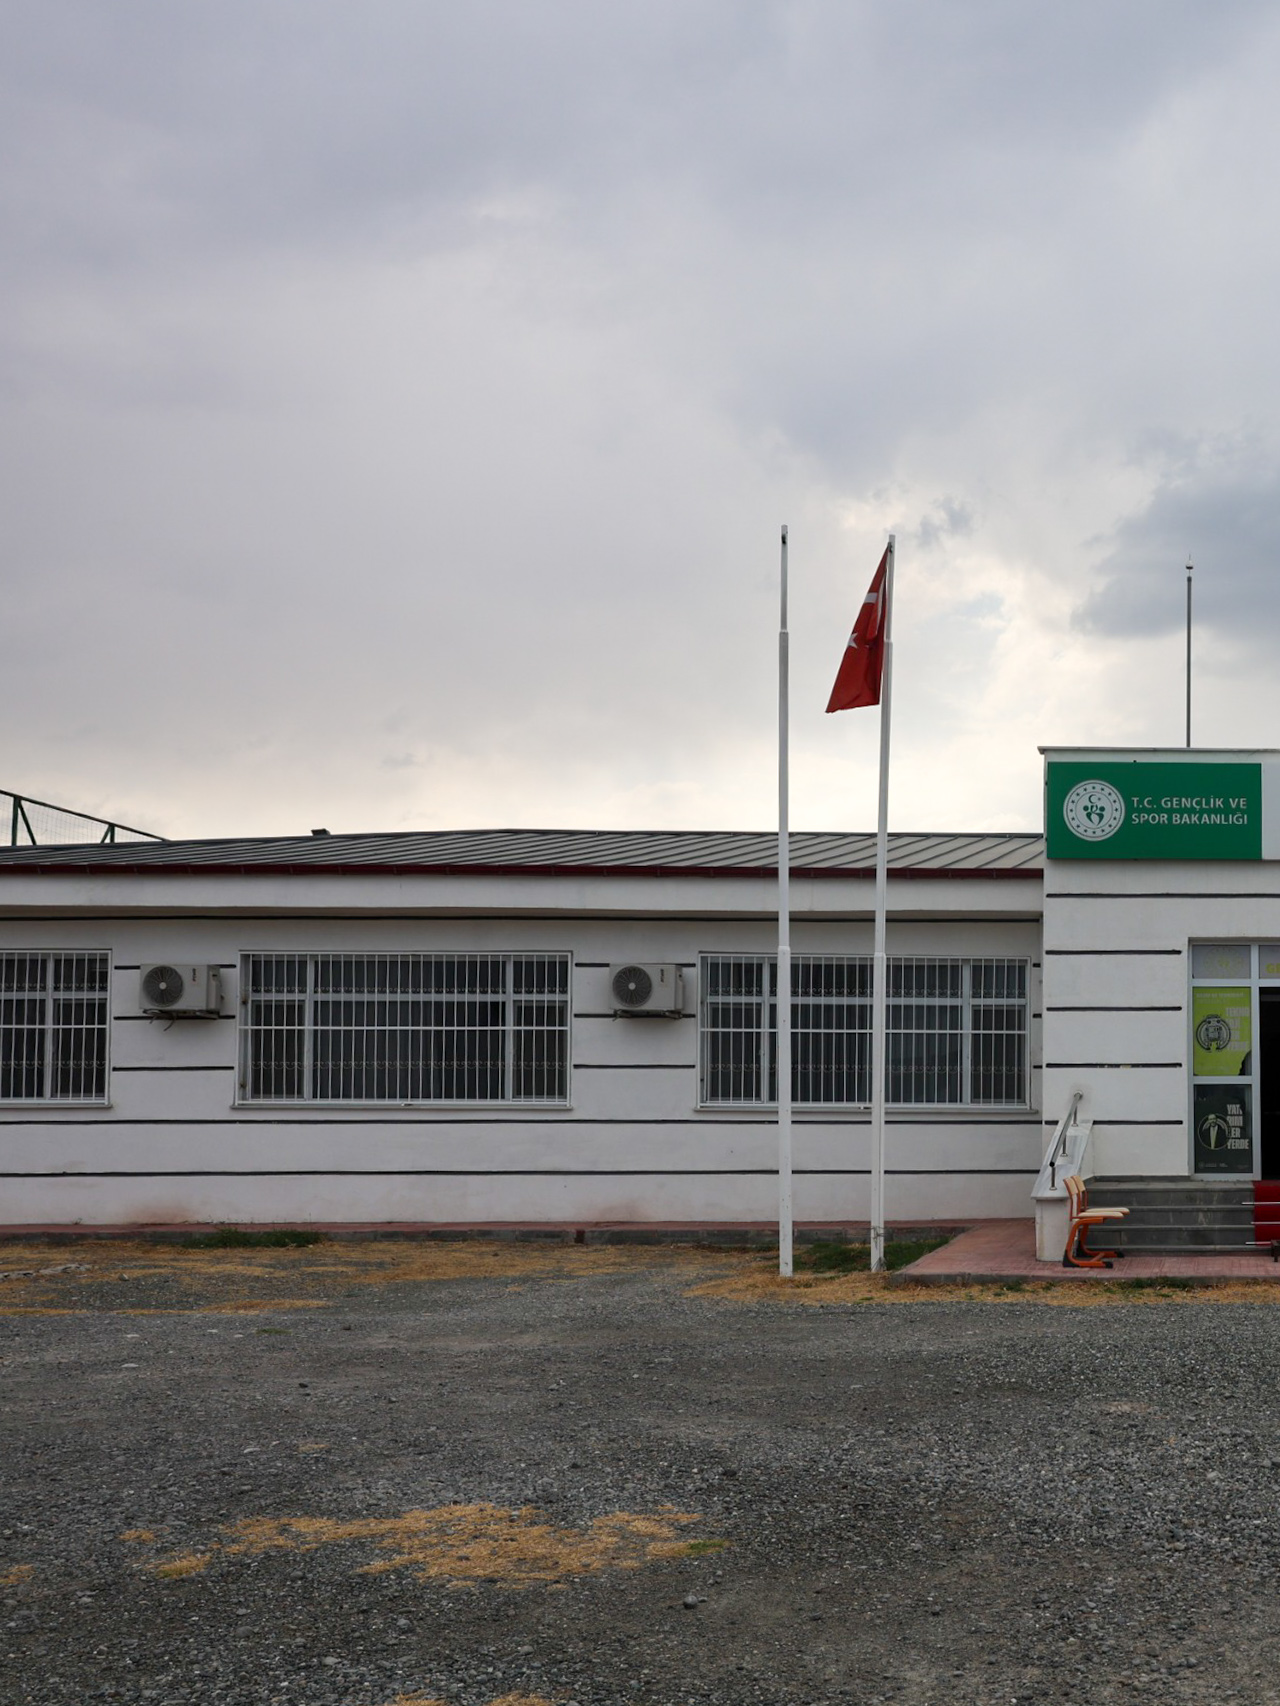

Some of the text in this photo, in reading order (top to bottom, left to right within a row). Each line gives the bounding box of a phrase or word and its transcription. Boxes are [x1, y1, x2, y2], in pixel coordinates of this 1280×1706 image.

[1131, 795, 1248, 811] T.C. GENÇLİK VE
[1131, 810, 1248, 826] SPOR BAKANLIĞI
